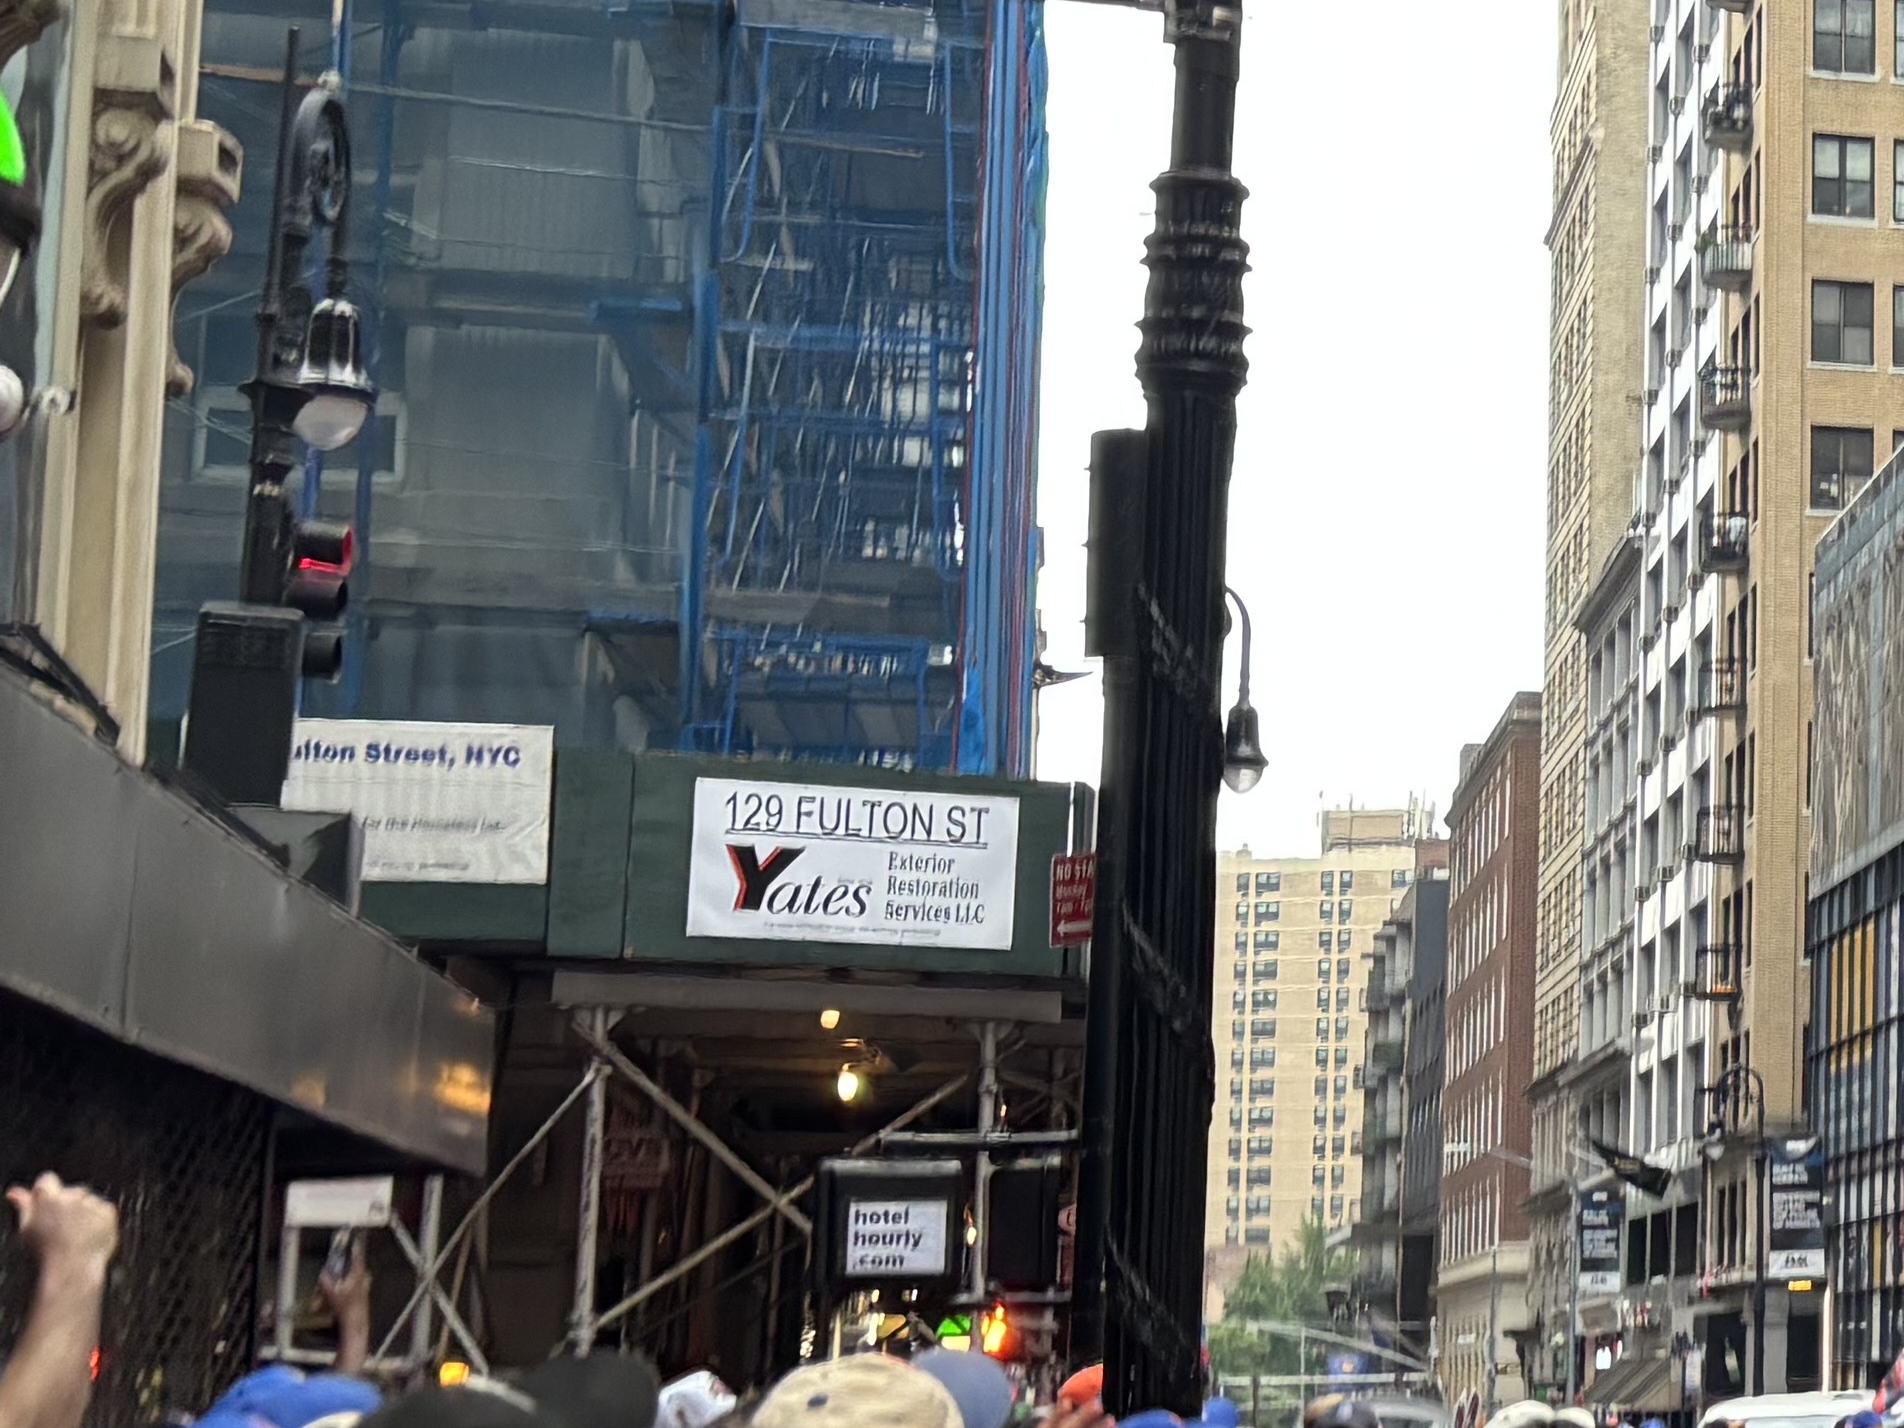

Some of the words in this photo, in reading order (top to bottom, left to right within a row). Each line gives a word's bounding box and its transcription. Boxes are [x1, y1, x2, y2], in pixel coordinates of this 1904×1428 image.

[365, 742, 456, 771] Street,
[465, 744, 522, 767] NYC
[725, 791, 783, 832] 129
[796, 796, 934, 842] FULTON
[946, 806, 990, 844] ST
[888, 851, 955, 874] Exterior
[725, 843, 873, 918] Yates
[886, 876, 980, 900] Restoration
[884, 900, 951, 923] Services
[955, 903, 985, 924] LLC
[853, 1206, 910, 1225] hotel
[853, 1230, 923, 1250] hourly
[852, 1253, 905, 1270] .com
